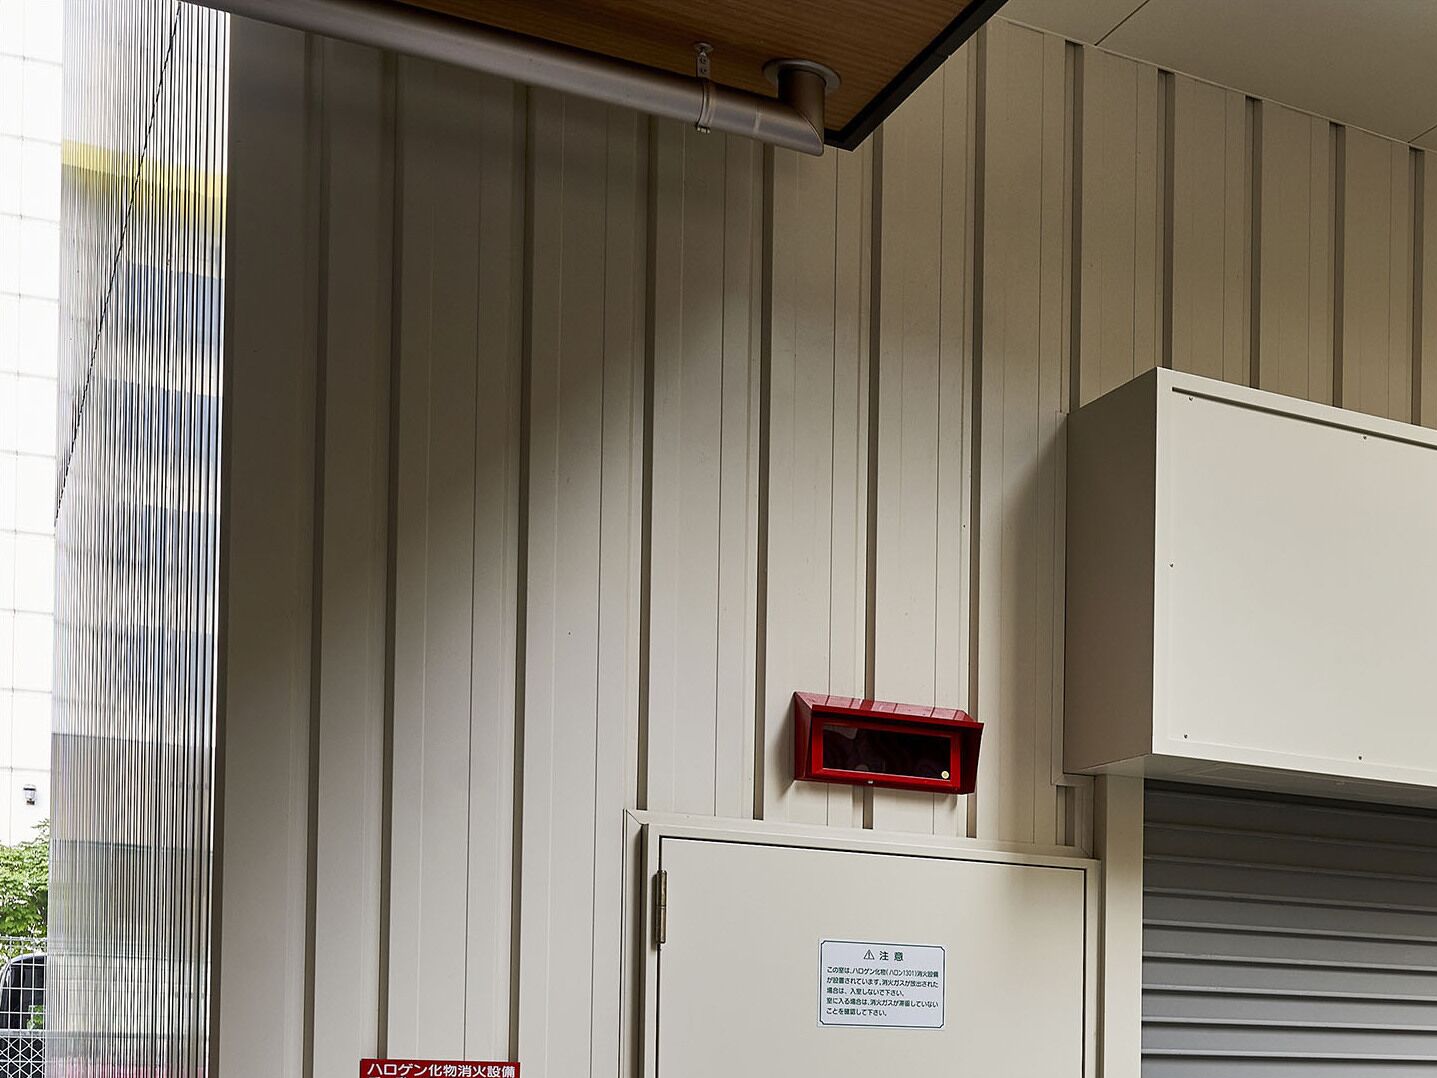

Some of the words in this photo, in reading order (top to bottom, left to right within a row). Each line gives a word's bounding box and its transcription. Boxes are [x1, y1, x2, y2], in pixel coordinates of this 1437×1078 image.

[367, 1063, 516, 1078] ハロゲン化物消火設備
